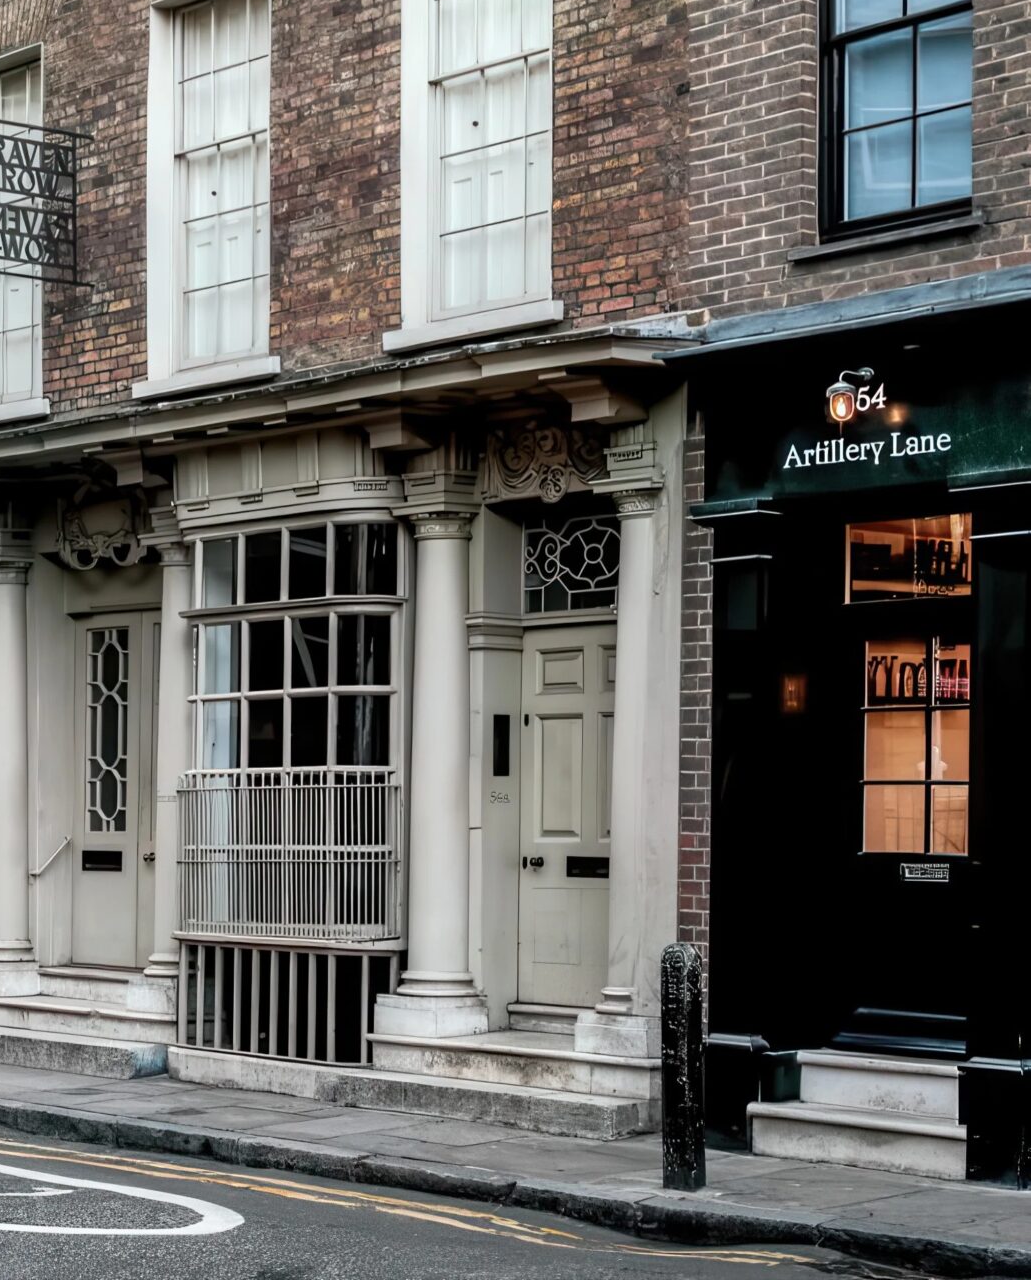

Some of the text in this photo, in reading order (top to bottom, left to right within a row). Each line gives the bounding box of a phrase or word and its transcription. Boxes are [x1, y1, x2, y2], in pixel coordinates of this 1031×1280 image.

[1, 165, 58, 197] ROW
[856, 383, 887, 412] 54
[783, 432, 952, 469] Artillery Lane
